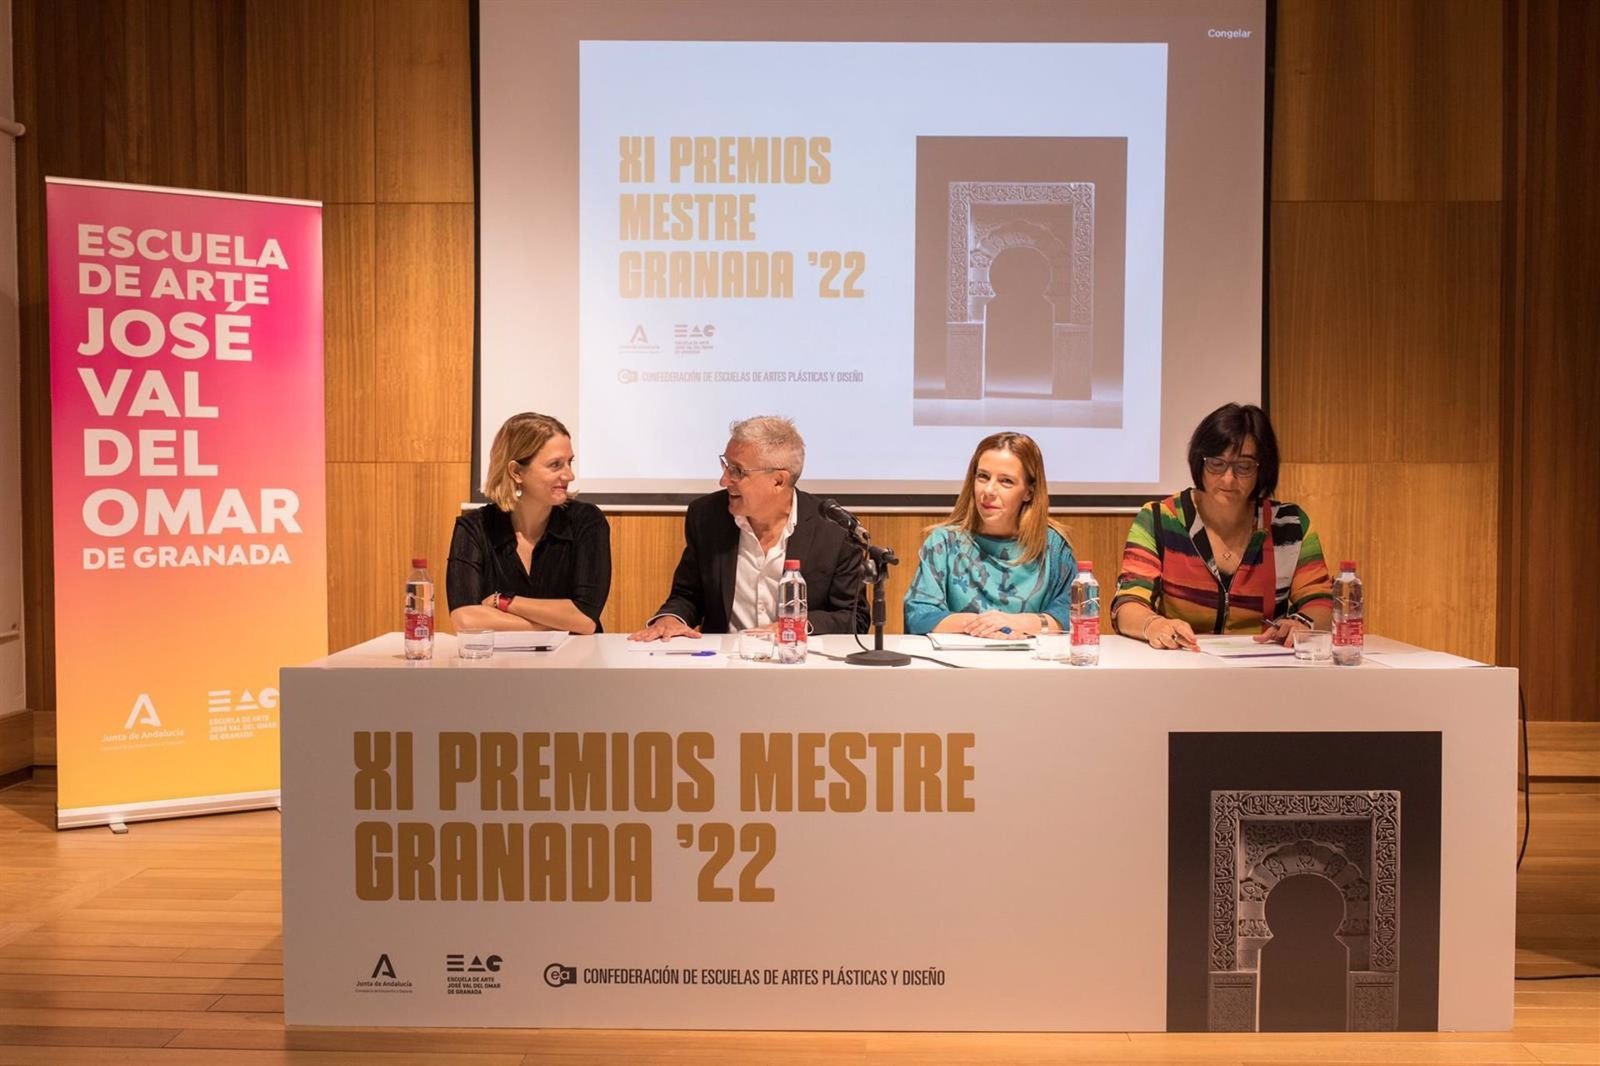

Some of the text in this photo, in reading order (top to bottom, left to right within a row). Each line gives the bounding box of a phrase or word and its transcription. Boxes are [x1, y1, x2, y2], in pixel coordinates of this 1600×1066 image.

[1207, 28, 1252, 39] Congelar
[619, 136, 832, 184] XI PREMIOS
[619, 193, 756, 241] MESTRE
[78, 223, 289, 270] ESCUELA
[79, 262, 269, 305] DE ARTE
[619, 251, 794, 298] GRANADA
[77, 300, 253, 361] JOSÉ
[77, 367, 219, 418] VAL
[703, 371, 714, 383] DE
[714, 371, 751, 383] ESCUELAS
[752, 371, 763, 383] DE
[764, 371, 787, 383] ARTES
[787, 369, 828, 383] PLÁSTICAS
[829, 371, 836, 383] Y
[836, 369, 863, 383] DISEÑO
[84, 428, 219, 477] DEL
[82, 488, 303, 537] OMAR
[83, 544, 292, 570] DE GRANADA
[354, 731, 976, 812] XI PREMIOS MESTRE
[355, 821, 653, 902] GRANADA
[583, 965, 680, 985] CONFEDERACIÓN
[683, 969, 698, 985] DE
[701, 969, 760, 985] ESCUELAS
[763, 969, 779, 985] DE
[781, 969, 819, 985] ARTES
[822, 966, 887, 986] PLÁSTICAS
[891, 970, 899, 985] Y
[902, 966, 946, 986] DISEÑO
